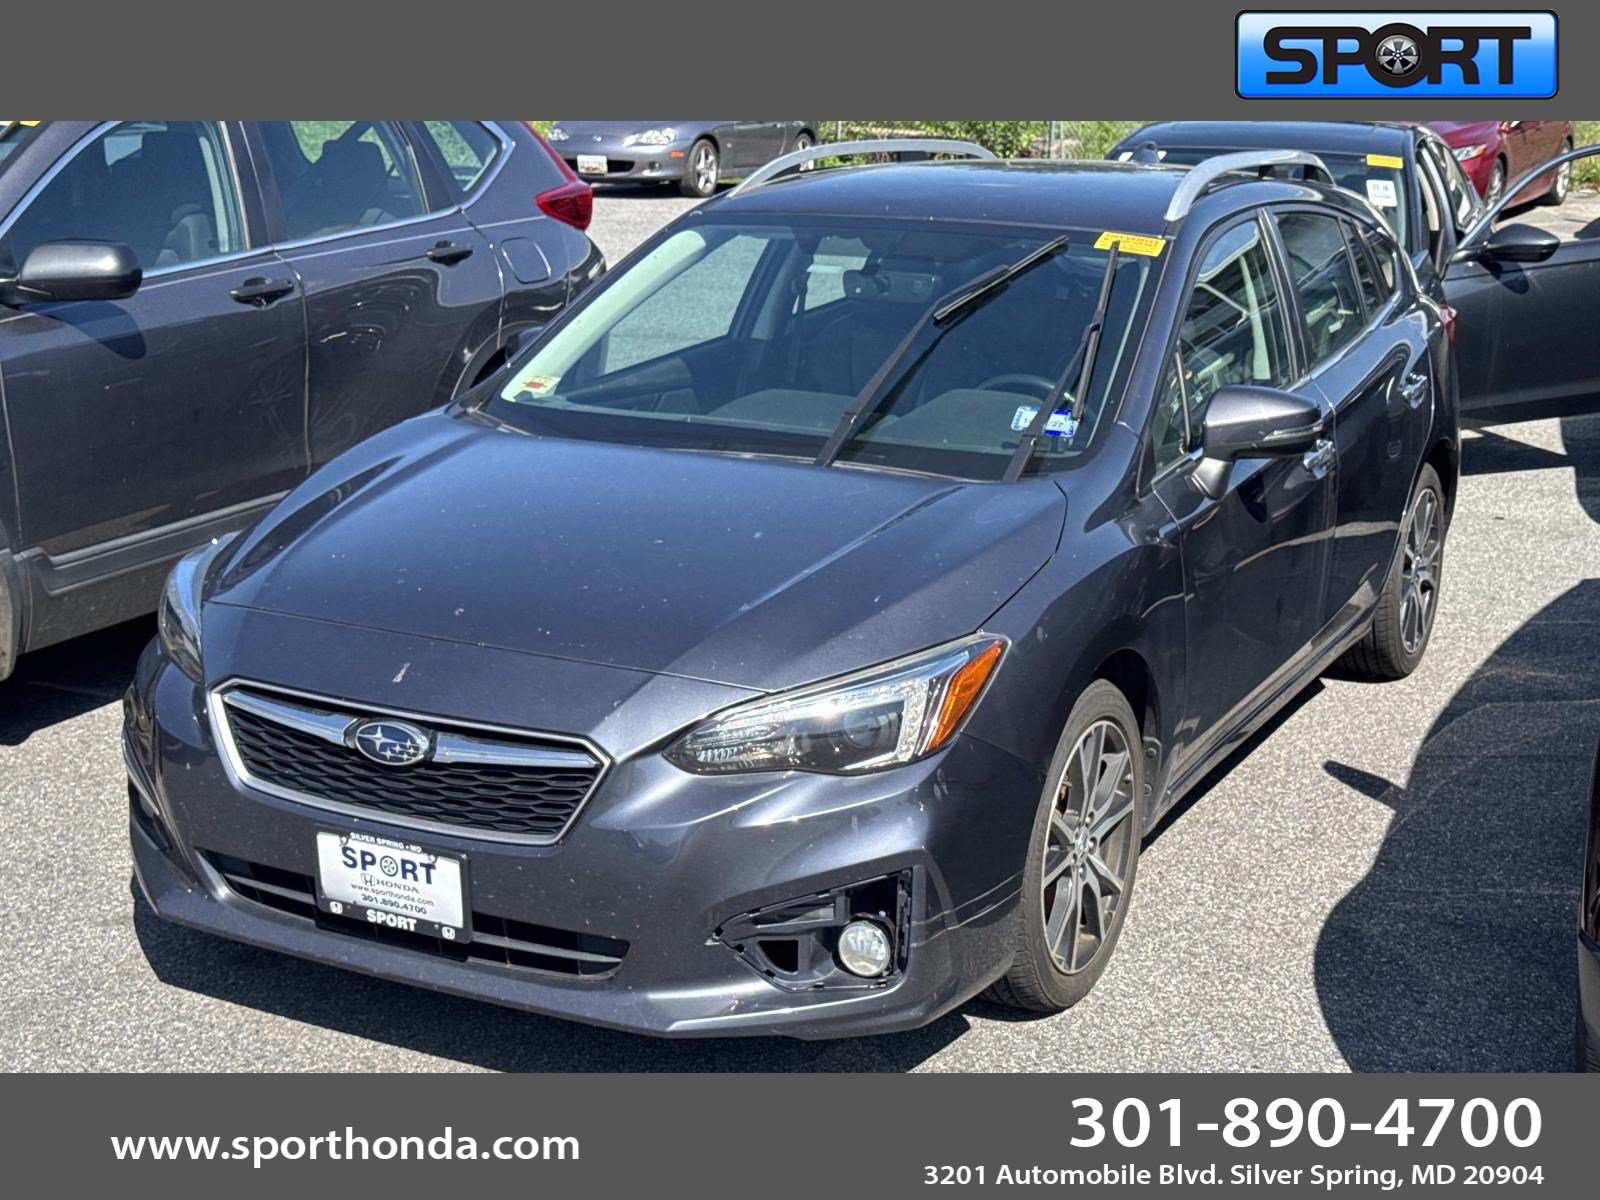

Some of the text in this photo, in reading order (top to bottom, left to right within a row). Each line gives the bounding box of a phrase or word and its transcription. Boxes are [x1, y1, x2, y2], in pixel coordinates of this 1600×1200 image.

[350, 832, 422, 853] SILVER SPRING MD
[341, 846, 436, 885] SPORT
[351, 883, 434, 907] www.sporthonda.com
[376, 878, 420, 894] HONDA
[366, 909, 417, 931] SPORT
